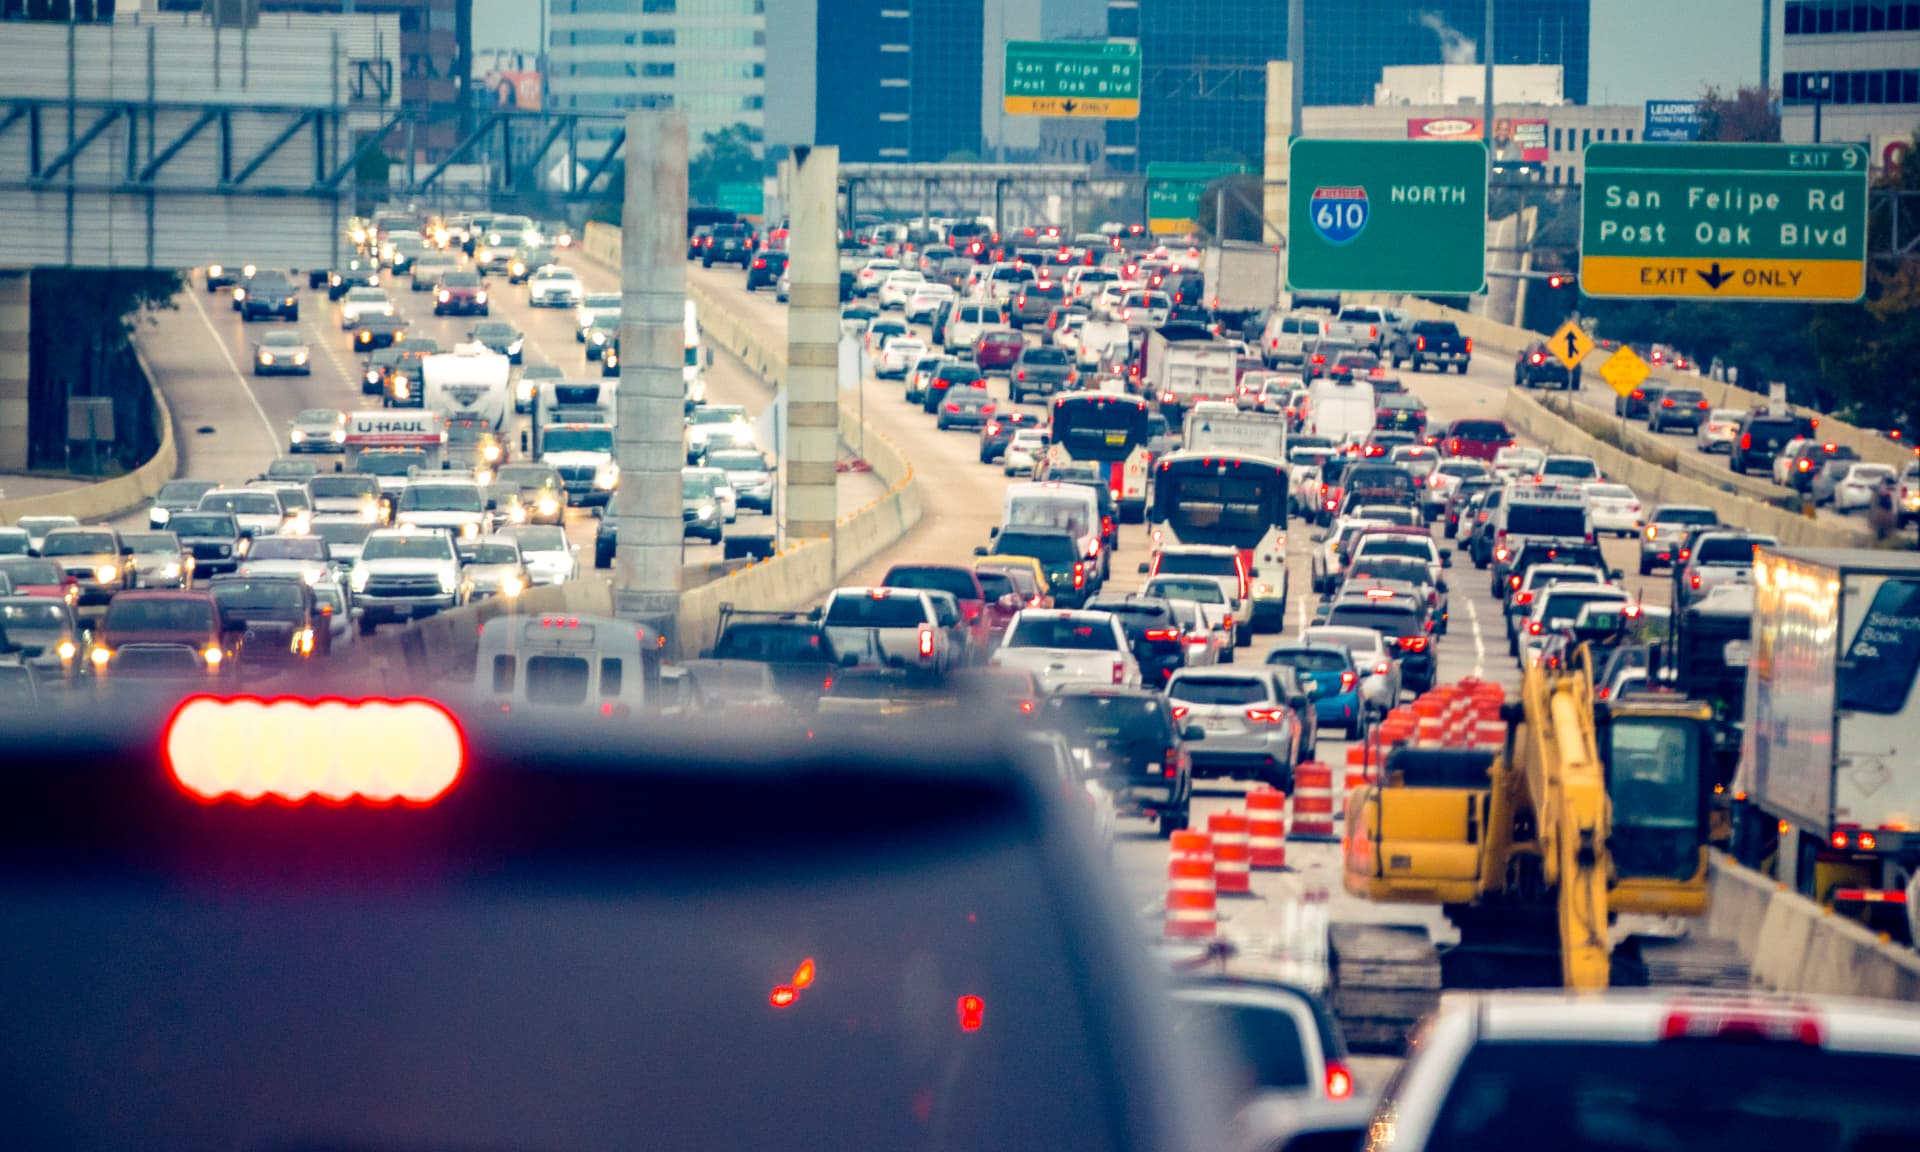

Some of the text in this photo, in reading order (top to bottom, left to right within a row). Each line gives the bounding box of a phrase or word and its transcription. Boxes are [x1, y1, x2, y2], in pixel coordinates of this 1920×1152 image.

[1016, 61, 1130, 78] San Felipe Rd
[1013, 79, 1131, 92] Post Oak Blvd
[1789, 149, 1858, 169] EXIT 9
[1391, 185, 1466, 203] NORTH
[1605, 185, 1845, 215] San Felipe Rd
[1316, 203, 1364, 230] 610
[1600, 220, 1848, 246] Post Oak Blvd
[1640, 267, 1803, 287] EXIT ONLY
